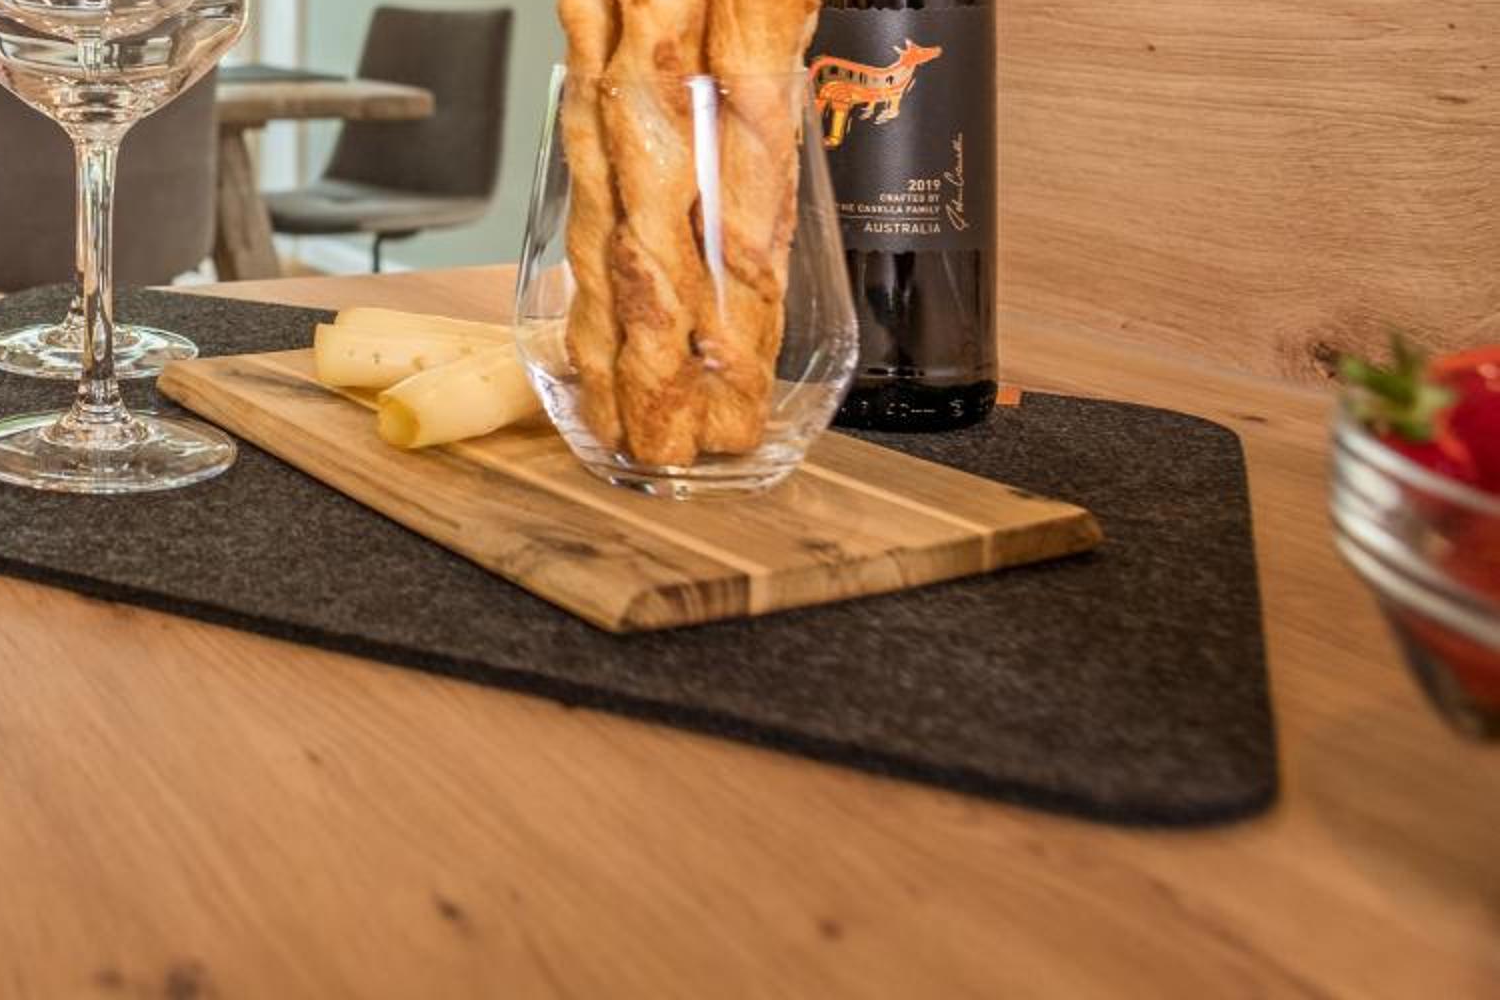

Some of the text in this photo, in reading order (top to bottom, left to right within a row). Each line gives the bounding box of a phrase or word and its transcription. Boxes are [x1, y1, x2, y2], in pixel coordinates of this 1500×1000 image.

[908, 179, 941, 191] 2019
[879, 193, 940, 202] CRAFTED BY
[857, 204, 902, 213] CASELLA
[905, 205, 941, 214] FAMILY
[863, 222, 941, 233] AUSTRALIA
